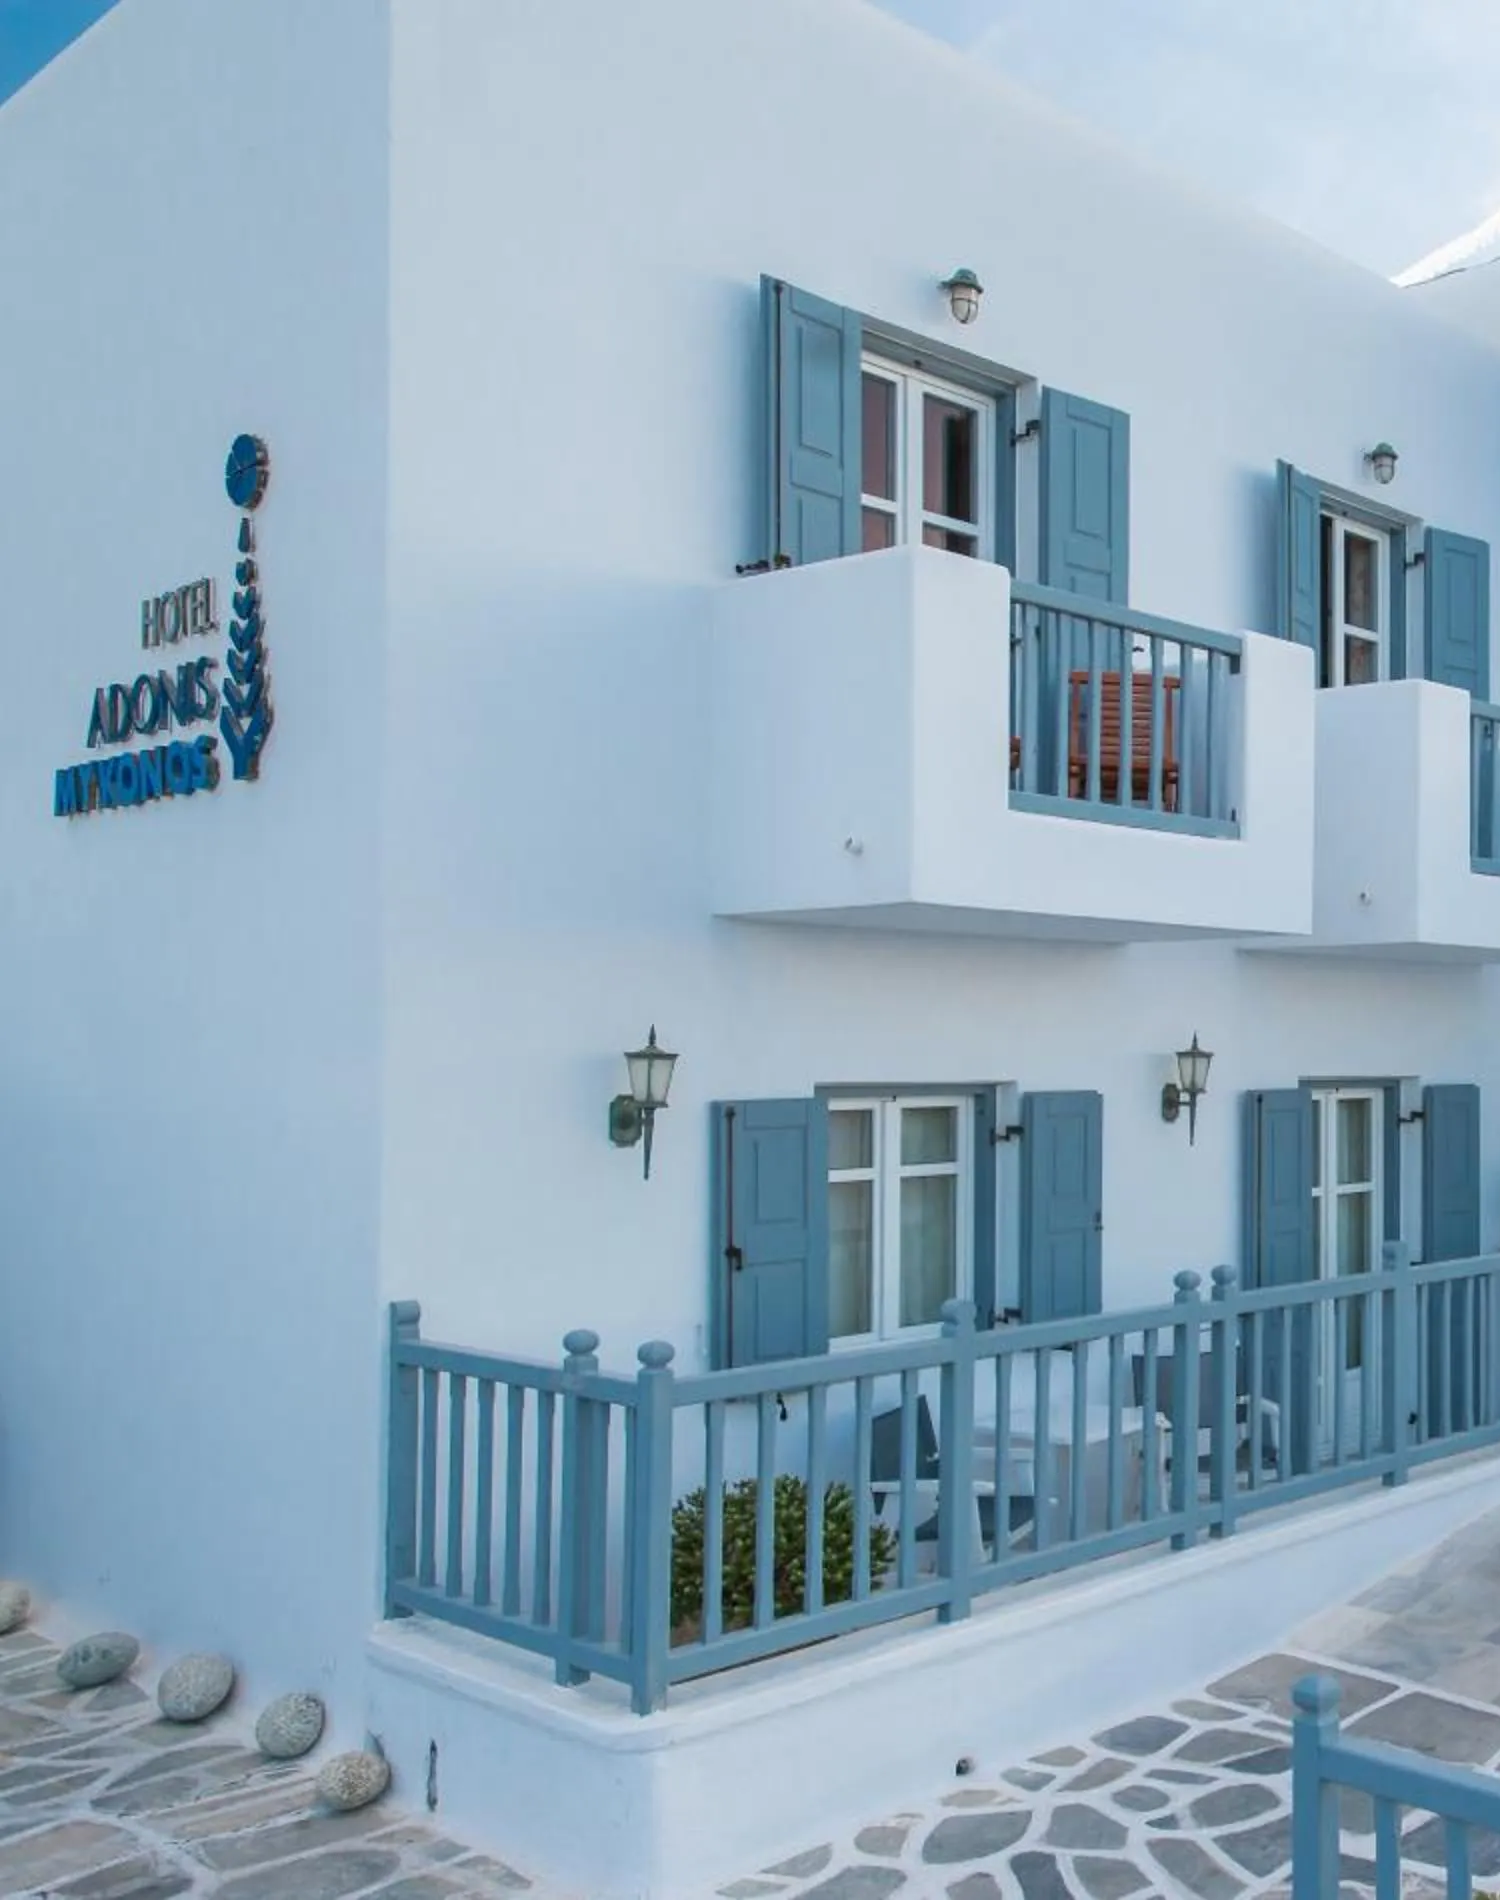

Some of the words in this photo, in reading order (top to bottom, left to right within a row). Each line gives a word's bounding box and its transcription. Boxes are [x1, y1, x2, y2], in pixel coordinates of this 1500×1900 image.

[141, 577, 219, 649] HOTEL
[87, 656, 220, 748] ADONIS
[54, 735, 220, 818] MYKONOS
